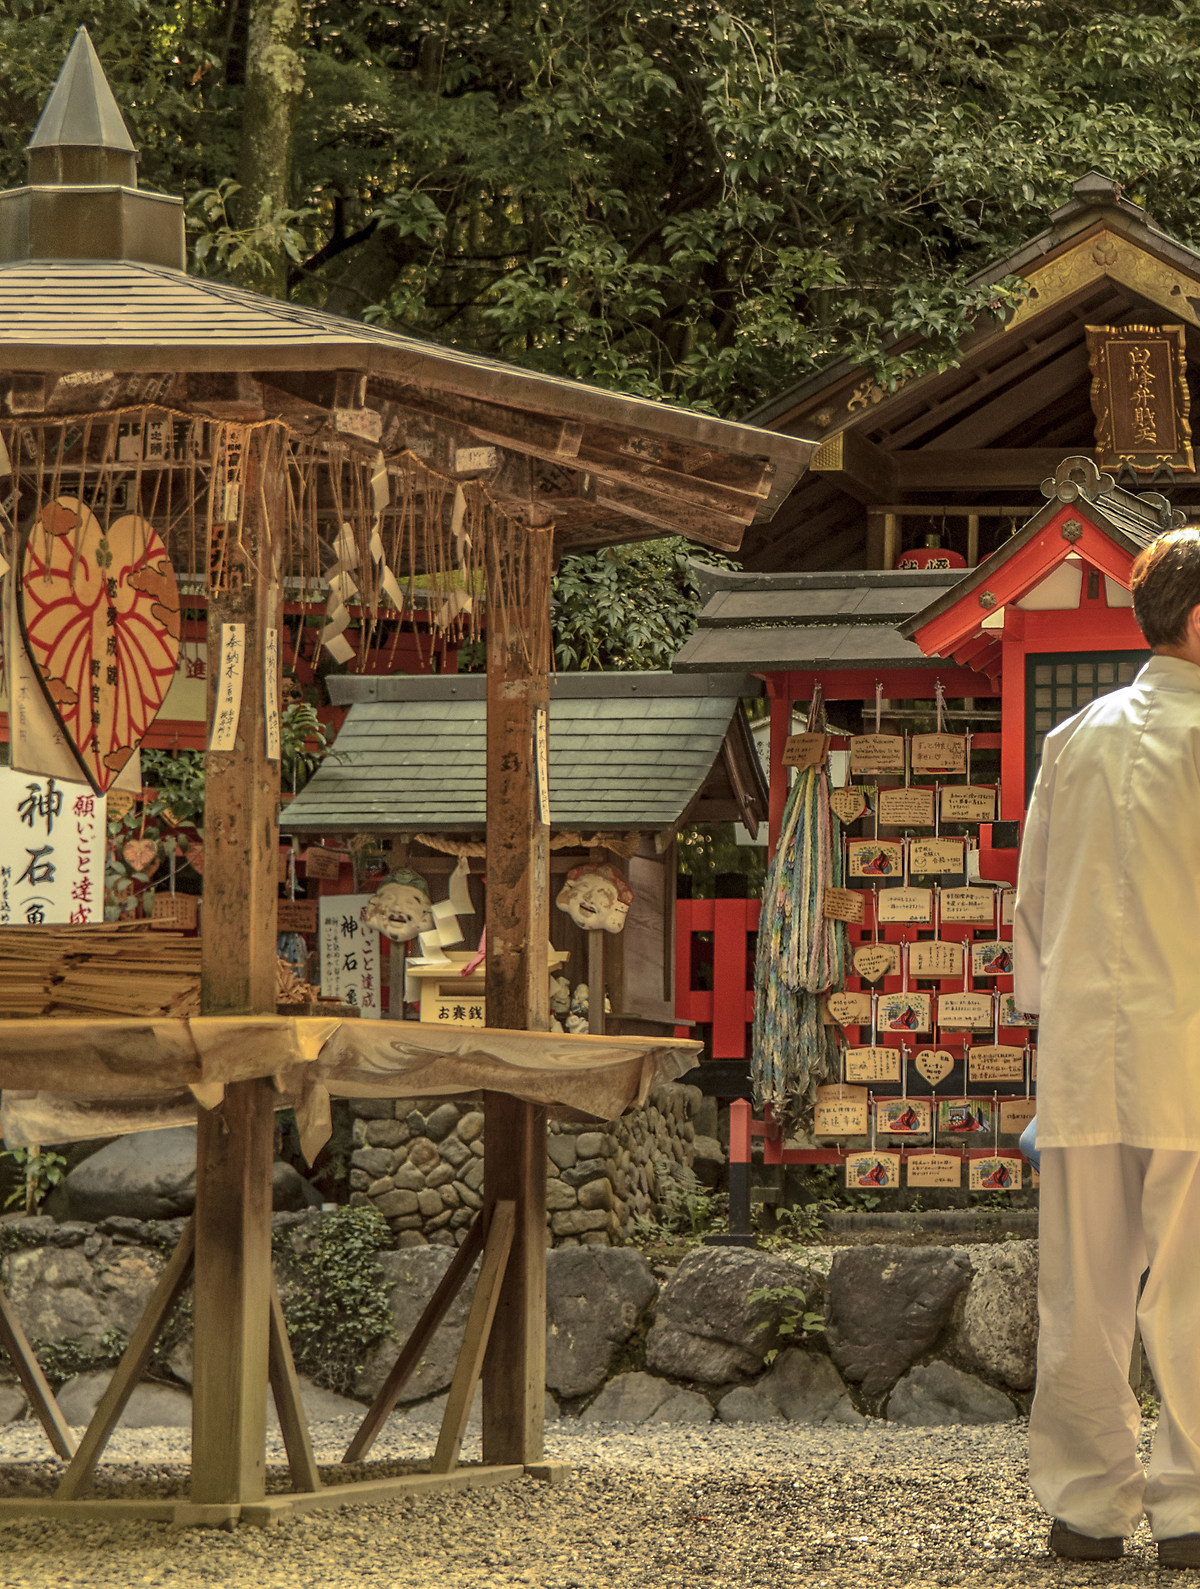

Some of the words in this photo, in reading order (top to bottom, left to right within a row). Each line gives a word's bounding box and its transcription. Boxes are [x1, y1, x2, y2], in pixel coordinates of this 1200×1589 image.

[70, 794, 96, 924] 願いごと達成
[438, 1004, 483, 1021] お賽銭
